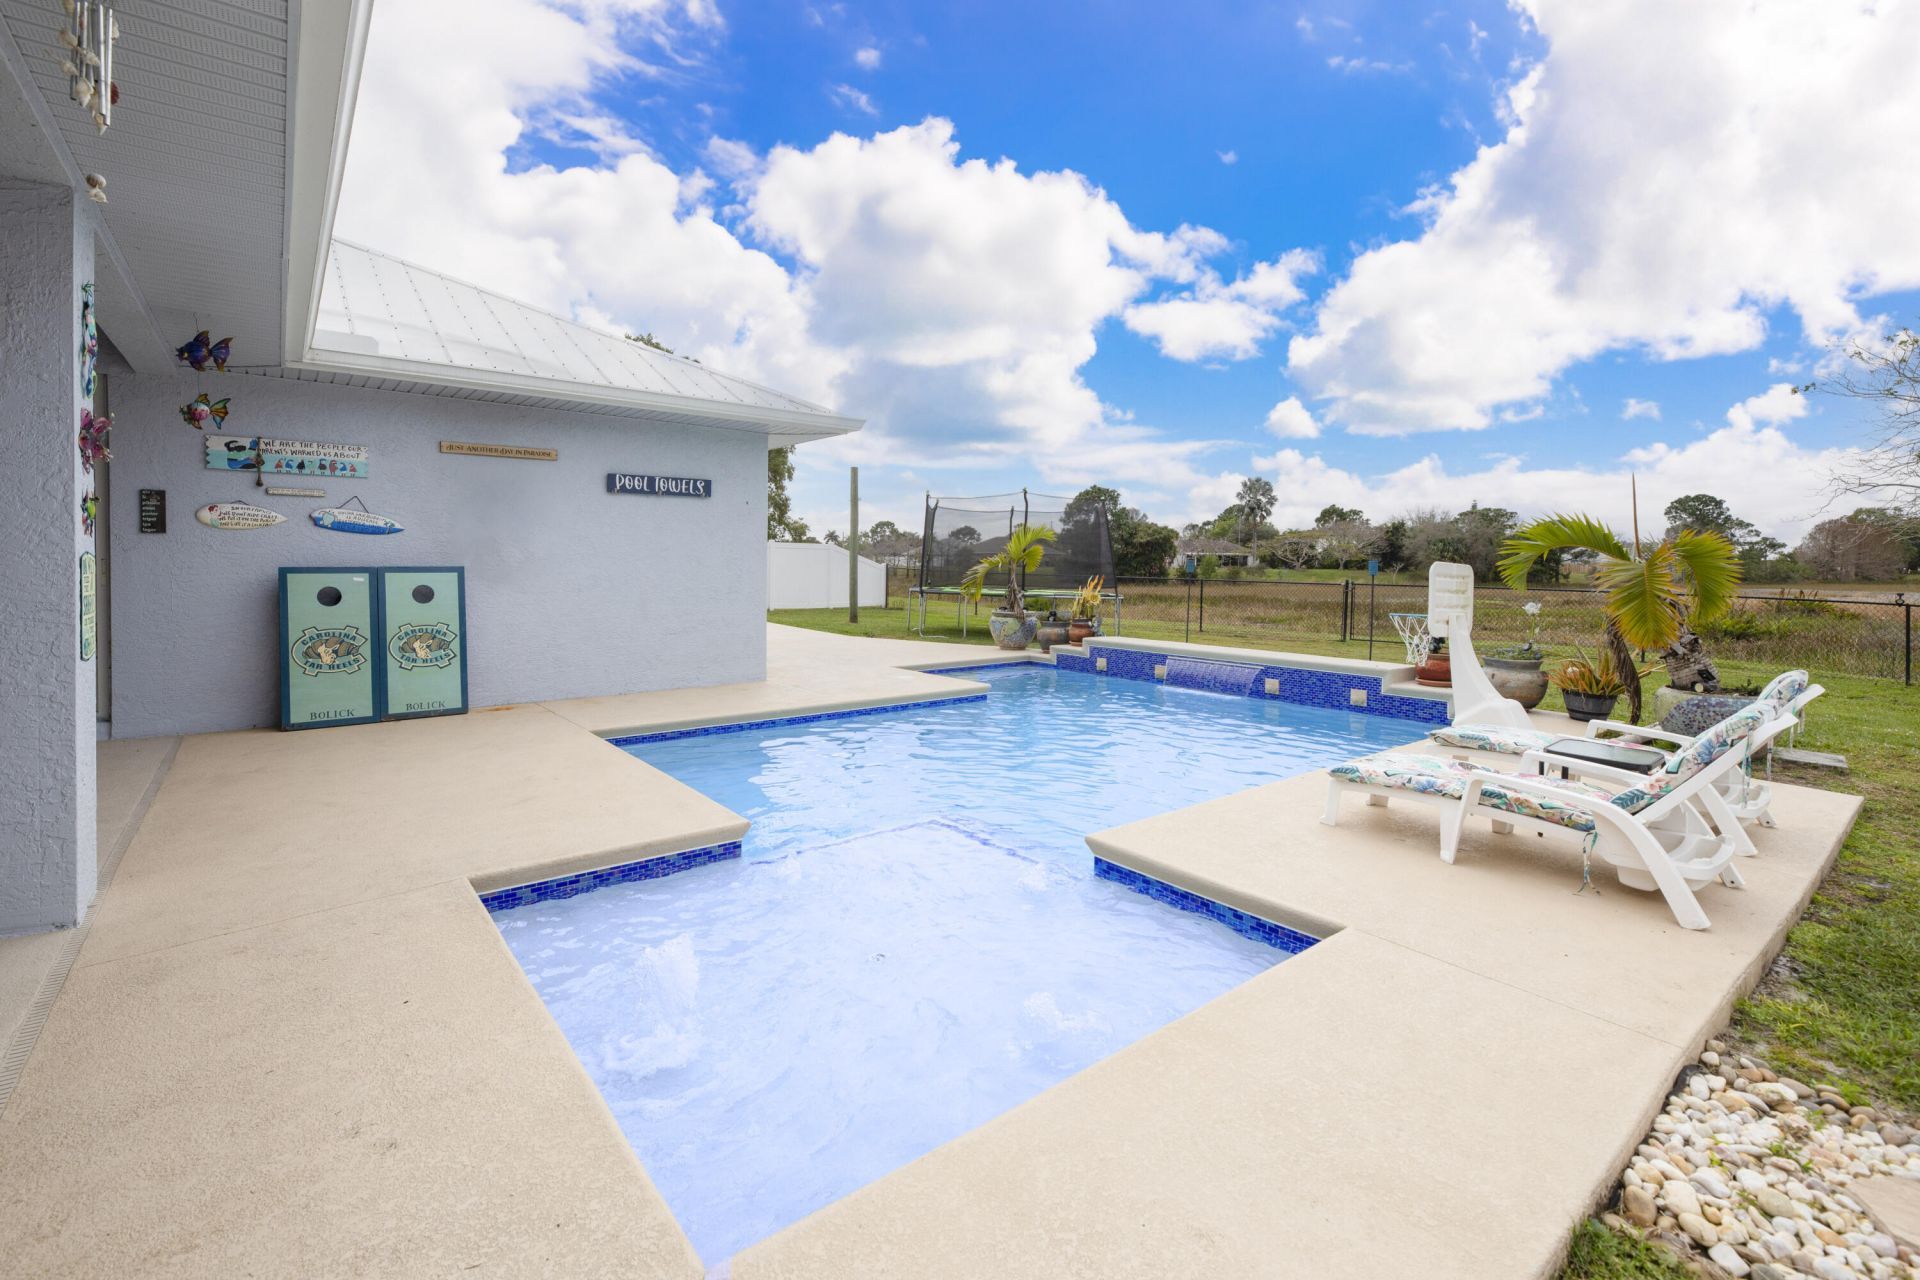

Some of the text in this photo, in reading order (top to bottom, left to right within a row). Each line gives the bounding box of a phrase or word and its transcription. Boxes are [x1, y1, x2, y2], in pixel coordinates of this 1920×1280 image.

[263, 440, 275, 448] WE
[279, 440, 296, 448] ARE
[300, 441, 314, 449] THE
[317, 442, 346, 451] PEOPLE
[466, 445, 499, 453] ANOTHER
[523, 449, 552, 457] PARADISE
[290, 449, 322, 457] WARNED
[334, 451, 361, 459] ABOUT
[615, 474, 705, 495] POOL TOWELS
[301, 631, 357, 645] CAROLINA
[398, 628, 447, 641] CAROLINA
[304, 658, 360, 670] TAR HEELS
[400, 652, 451, 664] TAR HEELS
[406, 700, 447, 711] BOLICK
[310, 708, 355, 721] BOLICK
